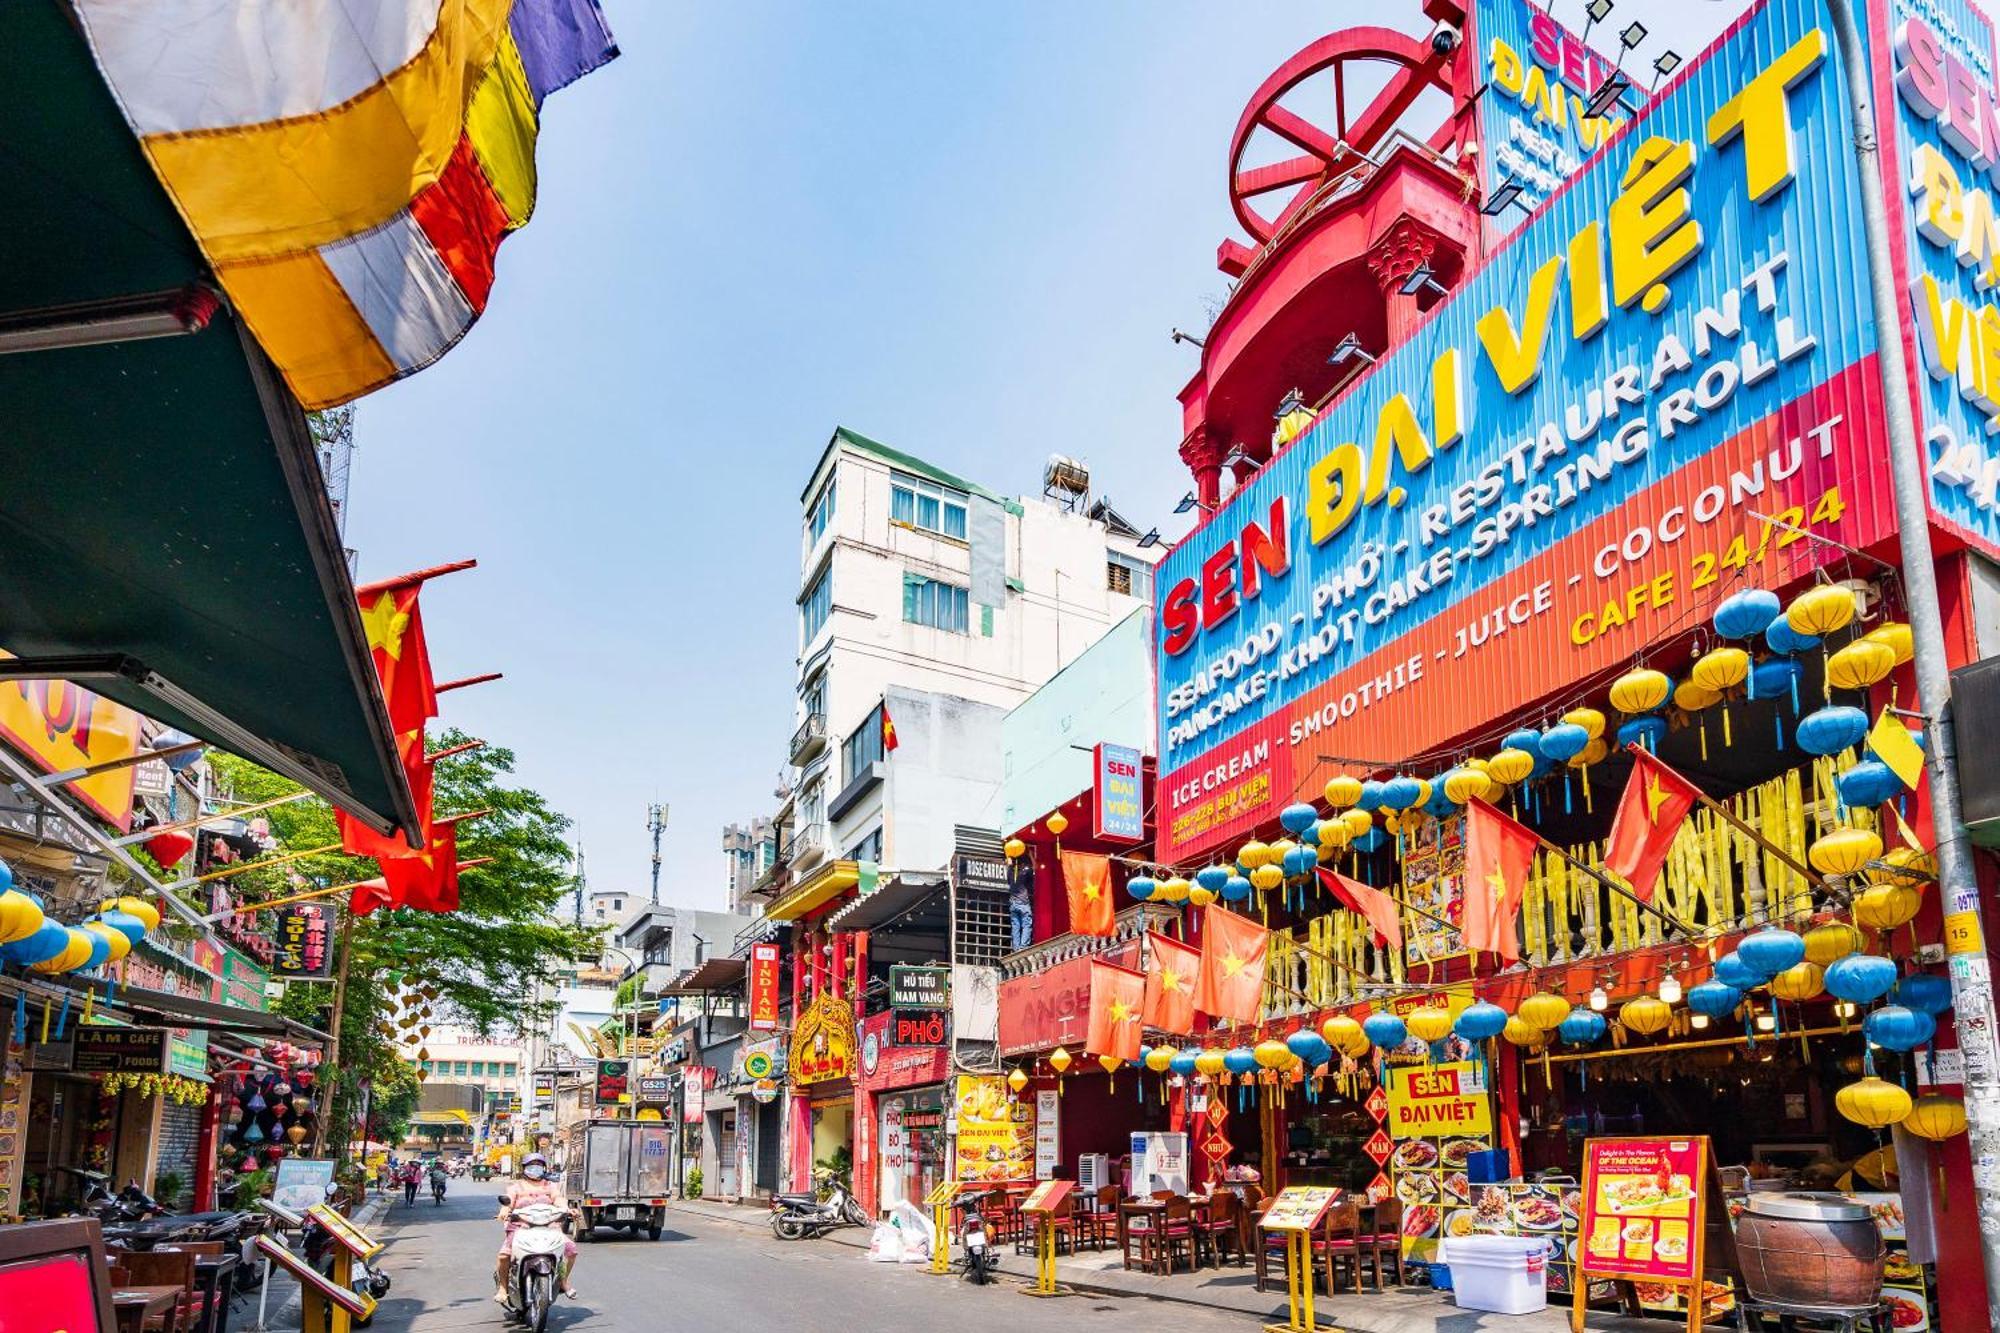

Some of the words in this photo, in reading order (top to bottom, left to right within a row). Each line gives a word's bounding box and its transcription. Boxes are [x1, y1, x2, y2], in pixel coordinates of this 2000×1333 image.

[1163, 495, 1292, 657] SEN
[1306, 347, 1464, 546] ĐẠI
[1476, 27, 1827, 396] VIỆT
[1658, 316, 1818, 439] ROLL
[1167, 621, 1284, 719] SEAFOOD
[1311, 541, 1385, 622] PHỞ
[1421, 252, 1790, 547] RESTAURANT
[1571, 570, 1675, 646] CAFE
[1692, 485, 1847, 586] 24/24
[1172, 778, 1201, 809] ICE
[1202, 739, 1269, 791] CREAM
[1290, 652, 1424, 747] SMOOTHIE
[1454, 581, 1553, 659] JUICE
[1593, 414, 1844, 578] COCONUT
[1108, 761, 1136, 778] SEN
[1952, 928, 1968, 940] 15
[759, 961, 773, 1015] INDIAN
[895, 991, 917, 1003] NAM
[919, 992, 945, 1003] VANG
[898, 1013, 944, 1043] PHỞ
[125, 1056, 160, 1067] FOODS
[642, 1080, 666, 1089] GS25
[1415, 1073, 1453, 1097] SEN
[1400, 1104, 1430, 1128] ĐẠI
[1433, 1097, 1477, 1126] VIỆT
[960, 1129, 976, 1137] SEN
